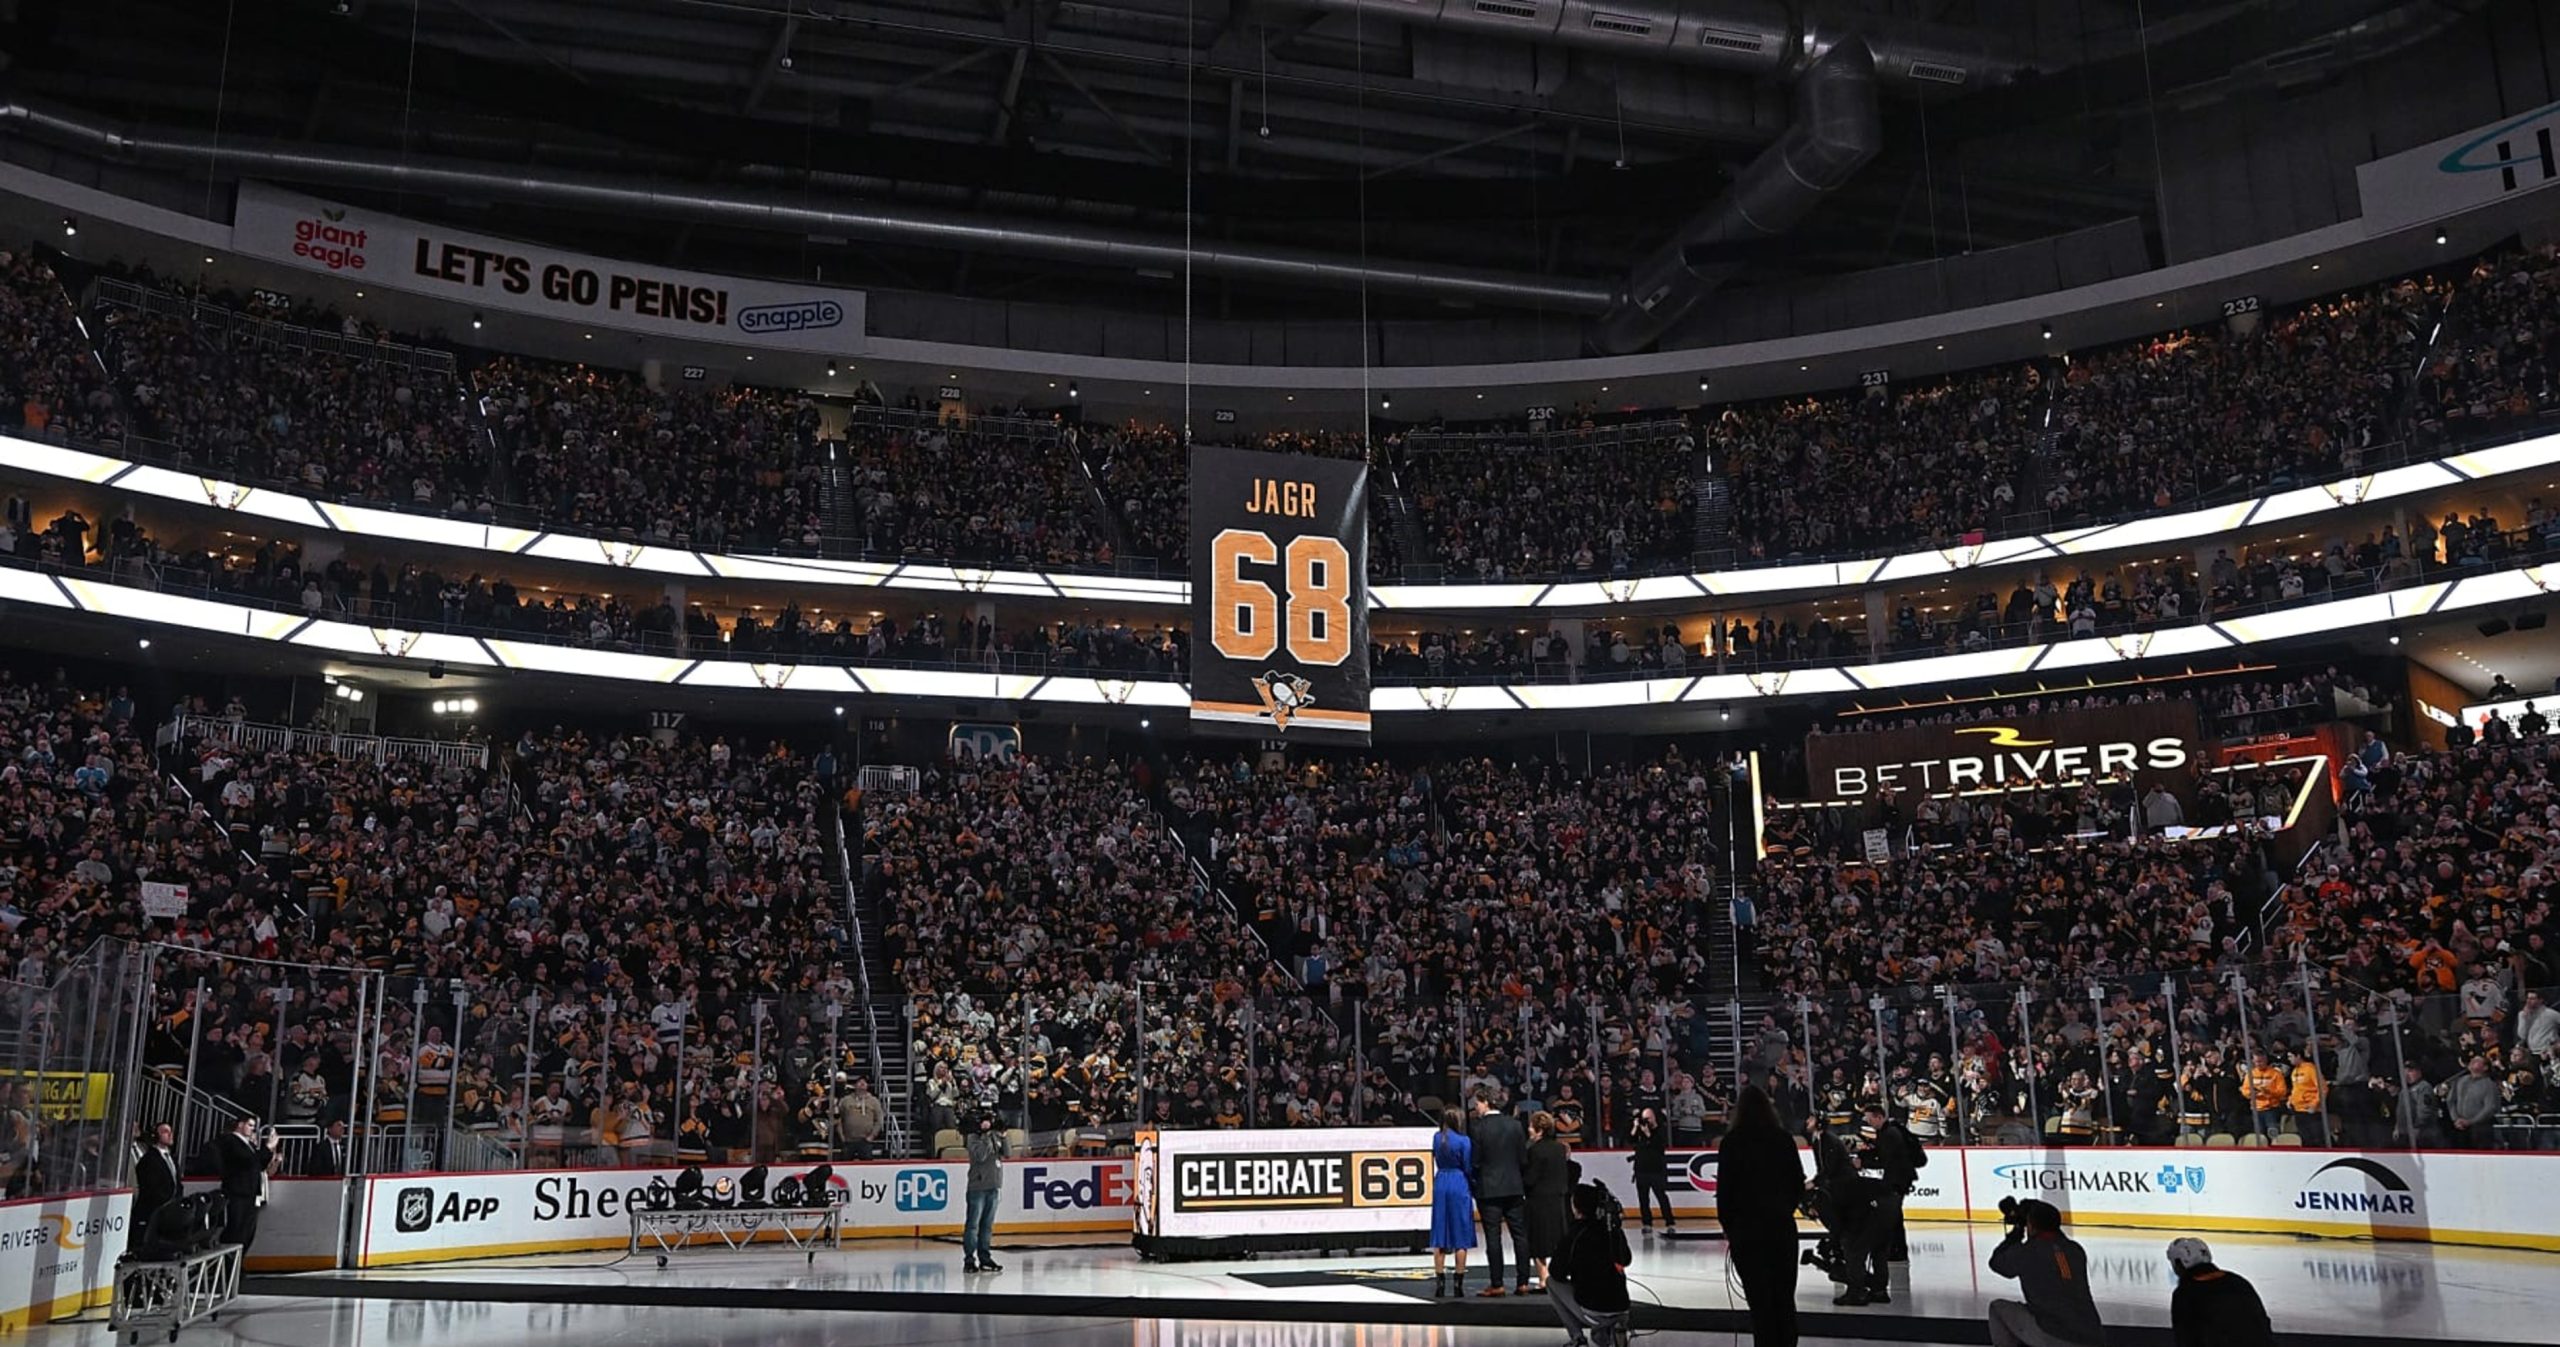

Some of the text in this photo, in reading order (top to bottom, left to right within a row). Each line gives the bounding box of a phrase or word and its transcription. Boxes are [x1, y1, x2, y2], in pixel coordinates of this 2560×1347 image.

[295, 219, 367, 249] giant
[293, 239, 366, 271] eagle
[414, 237, 729, 327] LET'S GO PENS!
[744, 300, 837, 331] snapple
[2223, 297, 2259, 317] 232
[684, 367, 705, 379] 227
[1862, 371, 1889, 386] 231
[1246, 478, 1316, 518] JAGR
[1211, 528, 1350, 666] 68
[651, 711, 685, 728] 117
[1835, 737, 2186, 796] BETRIVERS
[861, 1179, 887, 1203] by
[1181, 1156, 1426, 1201] CELEBRATE 68
[2010, 1168, 2151, 1193] HIGHMARK
[2294, 1191, 2415, 1215] JENNMAR
[0, 1216, 124, 1252] RIVERS CASINO
